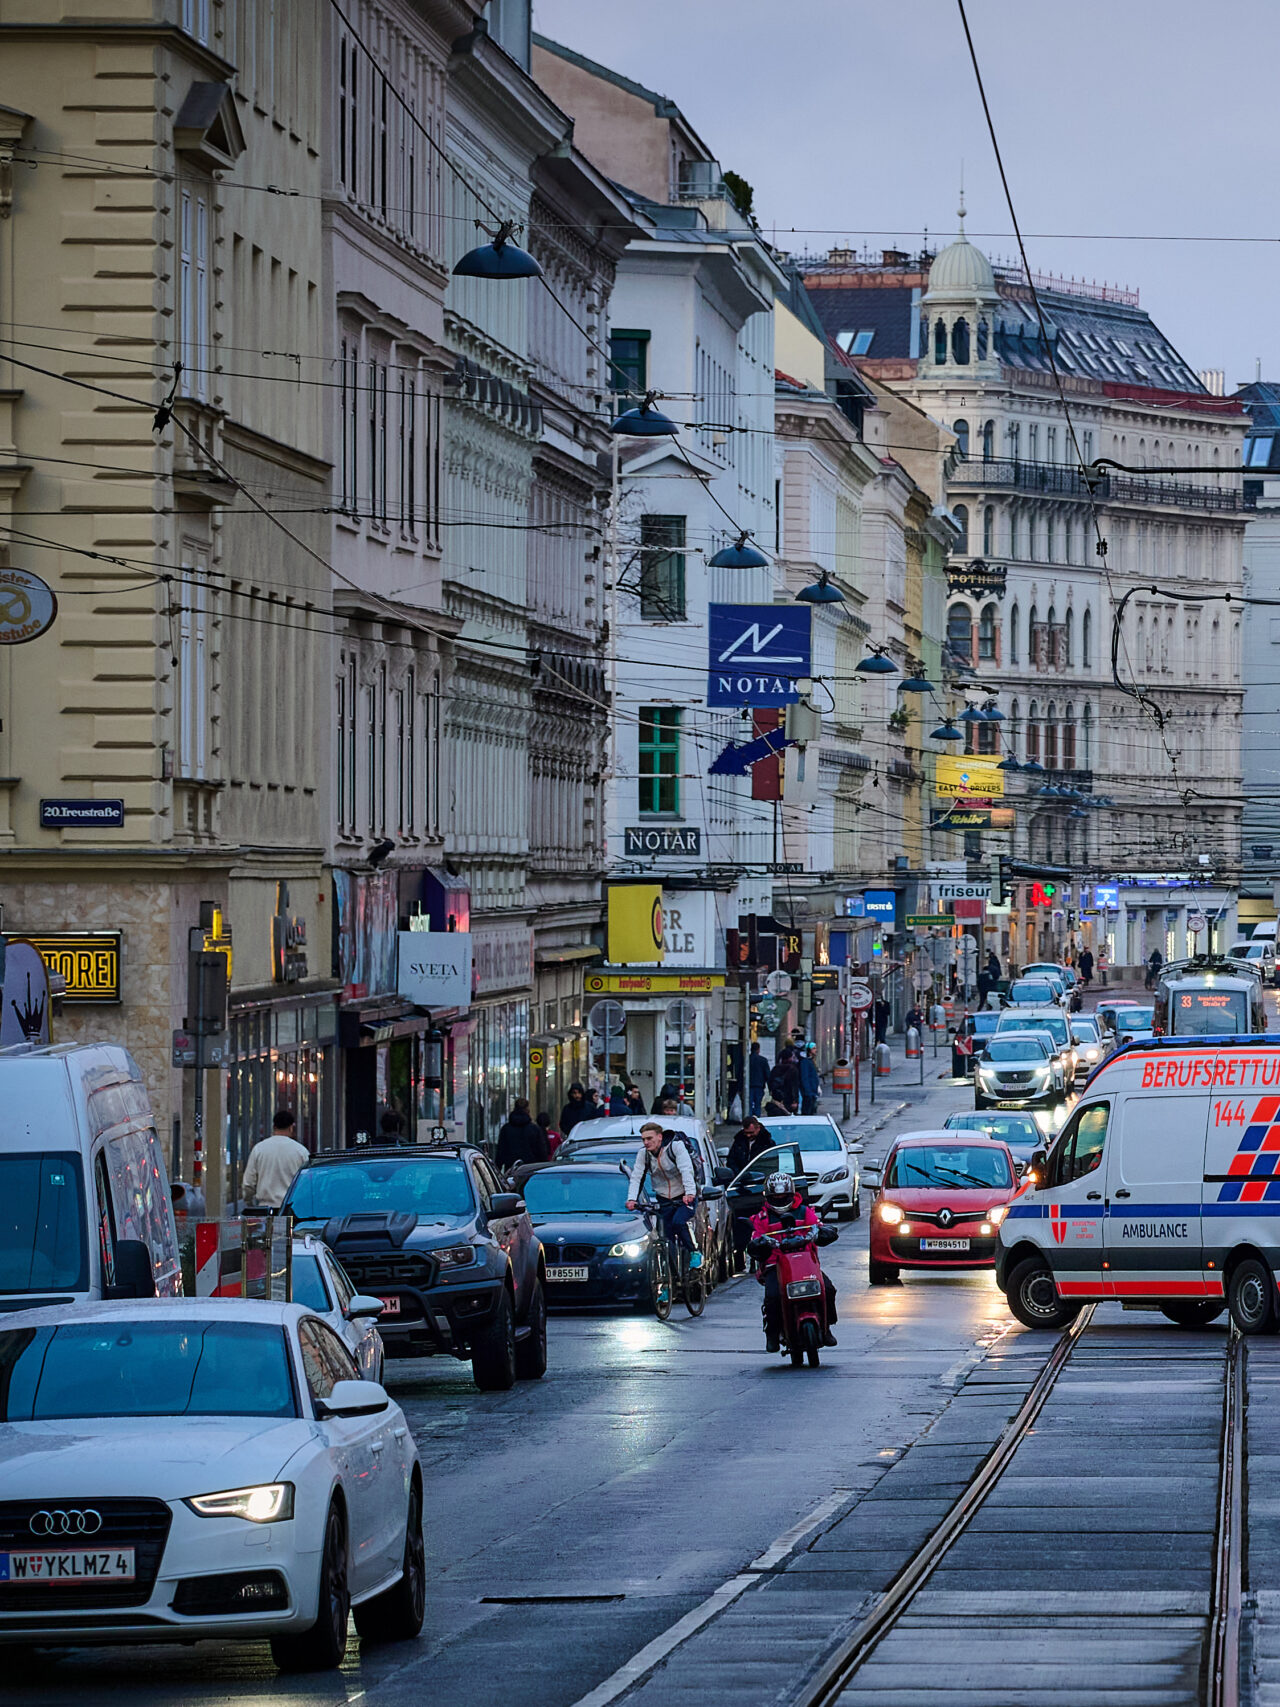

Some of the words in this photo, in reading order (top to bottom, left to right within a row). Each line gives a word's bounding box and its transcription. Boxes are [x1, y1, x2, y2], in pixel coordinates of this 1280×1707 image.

[629, 831, 698, 850] NOTAR
[938, 884, 992, 897] friseur
[866, 903, 886, 911] ERSTE
[410, 962, 458, 976] SVETA
[1181, 996, 1192, 1007] 33
[1214, 1100, 1246, 1128] 144
[1122, 1223, 1188, 1238] AMBULANCE
